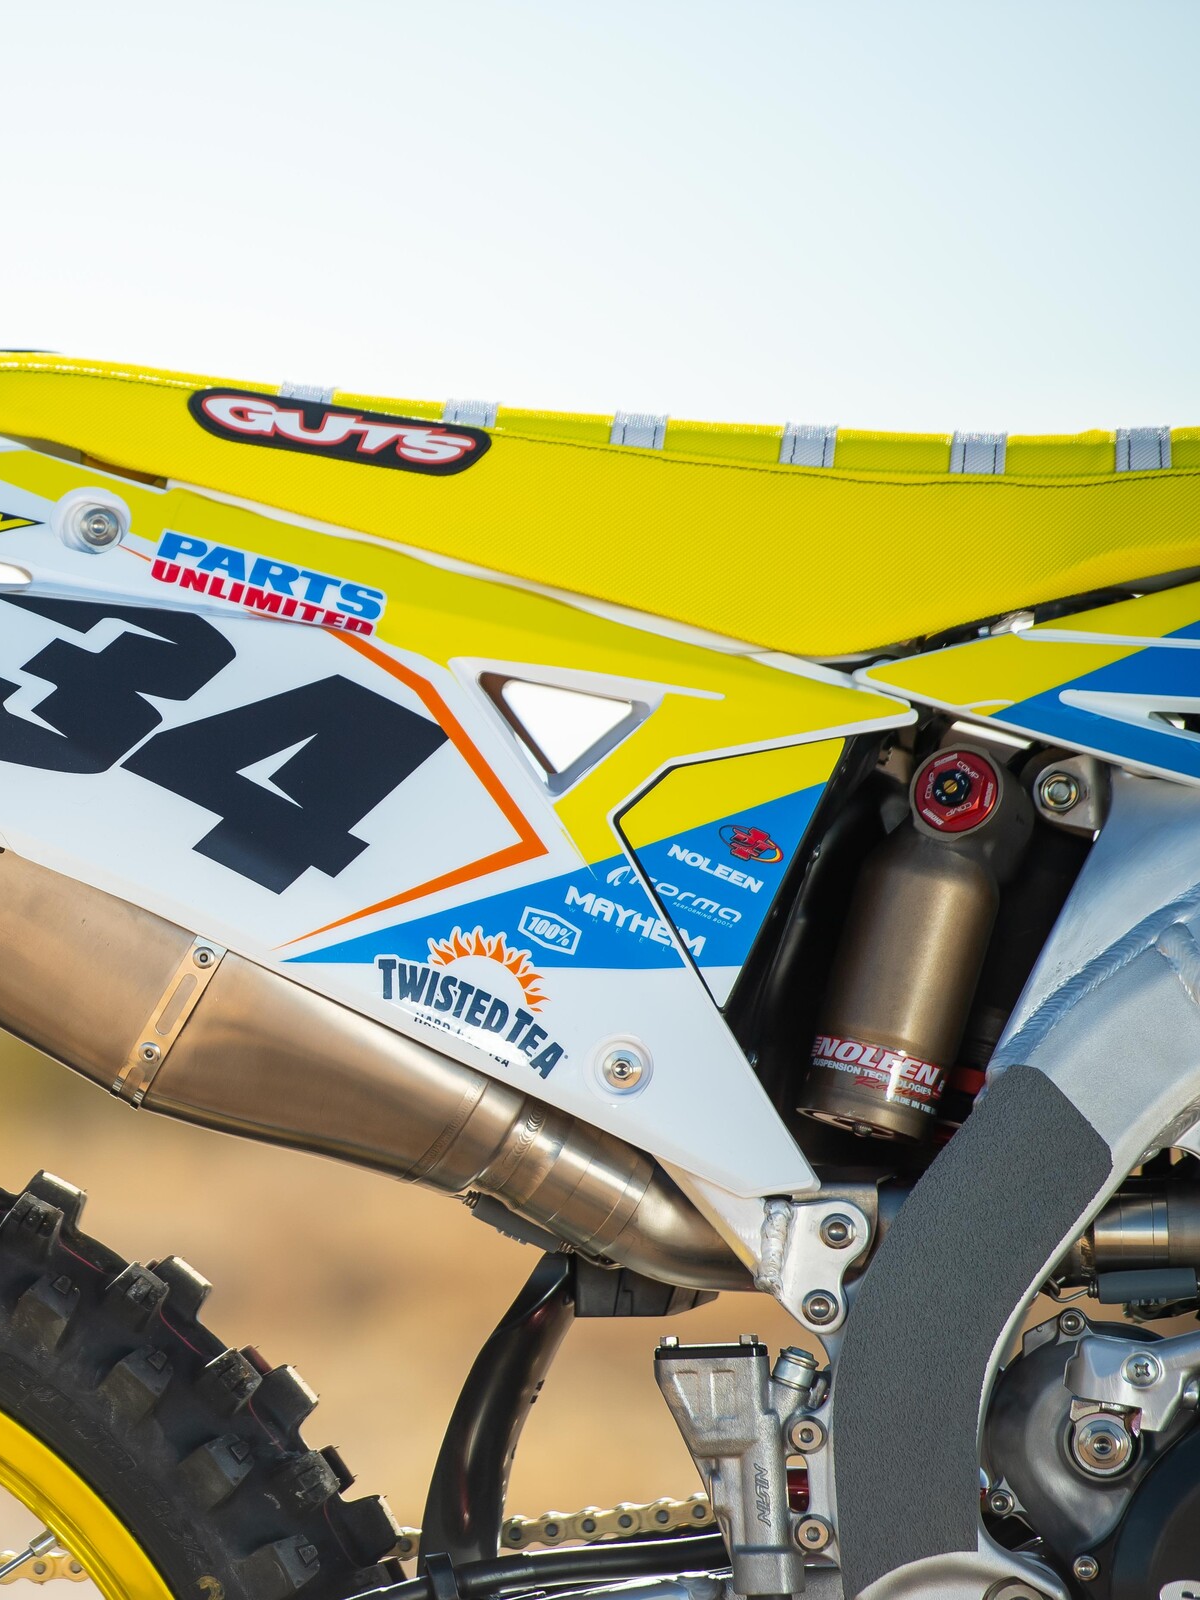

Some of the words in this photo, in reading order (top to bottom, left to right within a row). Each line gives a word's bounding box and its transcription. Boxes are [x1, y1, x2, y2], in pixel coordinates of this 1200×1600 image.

[201, 395, 477, 464] GUTS
[150, 559, 375, 636] UNLIMITED
[157, 532, 384, 620] PARTS
[956, 760, 980, 779] COMP
[667, 843, 765, 894] NOLEEN
[527, 917, 573, 946] 100%
[564, 885, 707, 957] MAYHEM
[378, 959, 510, 1034] TWISTED
[505, 1008, 565, 1080] TEA
[813, 1057, 861, 1076] SUSPENSION
[862, 1068, 932, 1095] TECHOLOGIES
[817, 1037, 940, 1086] NOLEEN
